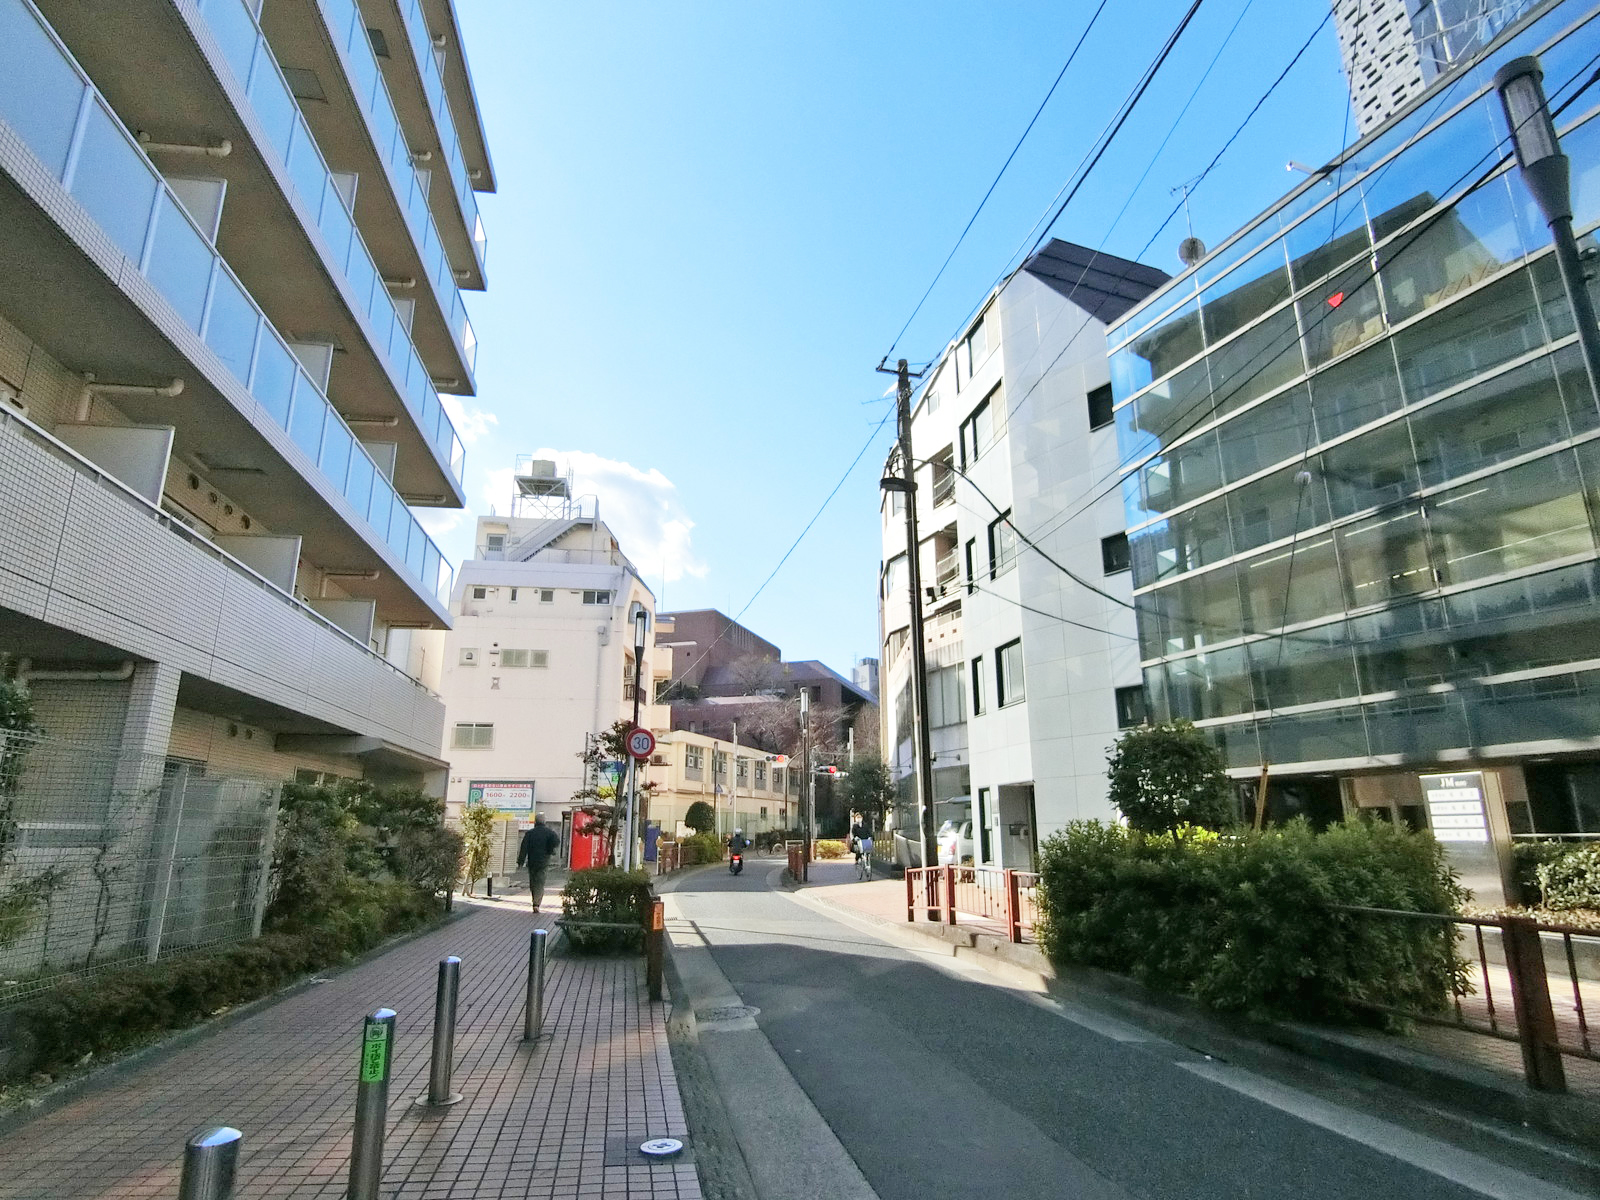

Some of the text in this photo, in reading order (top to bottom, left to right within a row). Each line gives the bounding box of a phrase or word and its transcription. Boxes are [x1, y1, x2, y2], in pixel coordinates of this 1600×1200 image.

[633, 736, 650, 750] 30
[1440, 777, 1454, 788] JM
[470, 789, 482, 803] P
